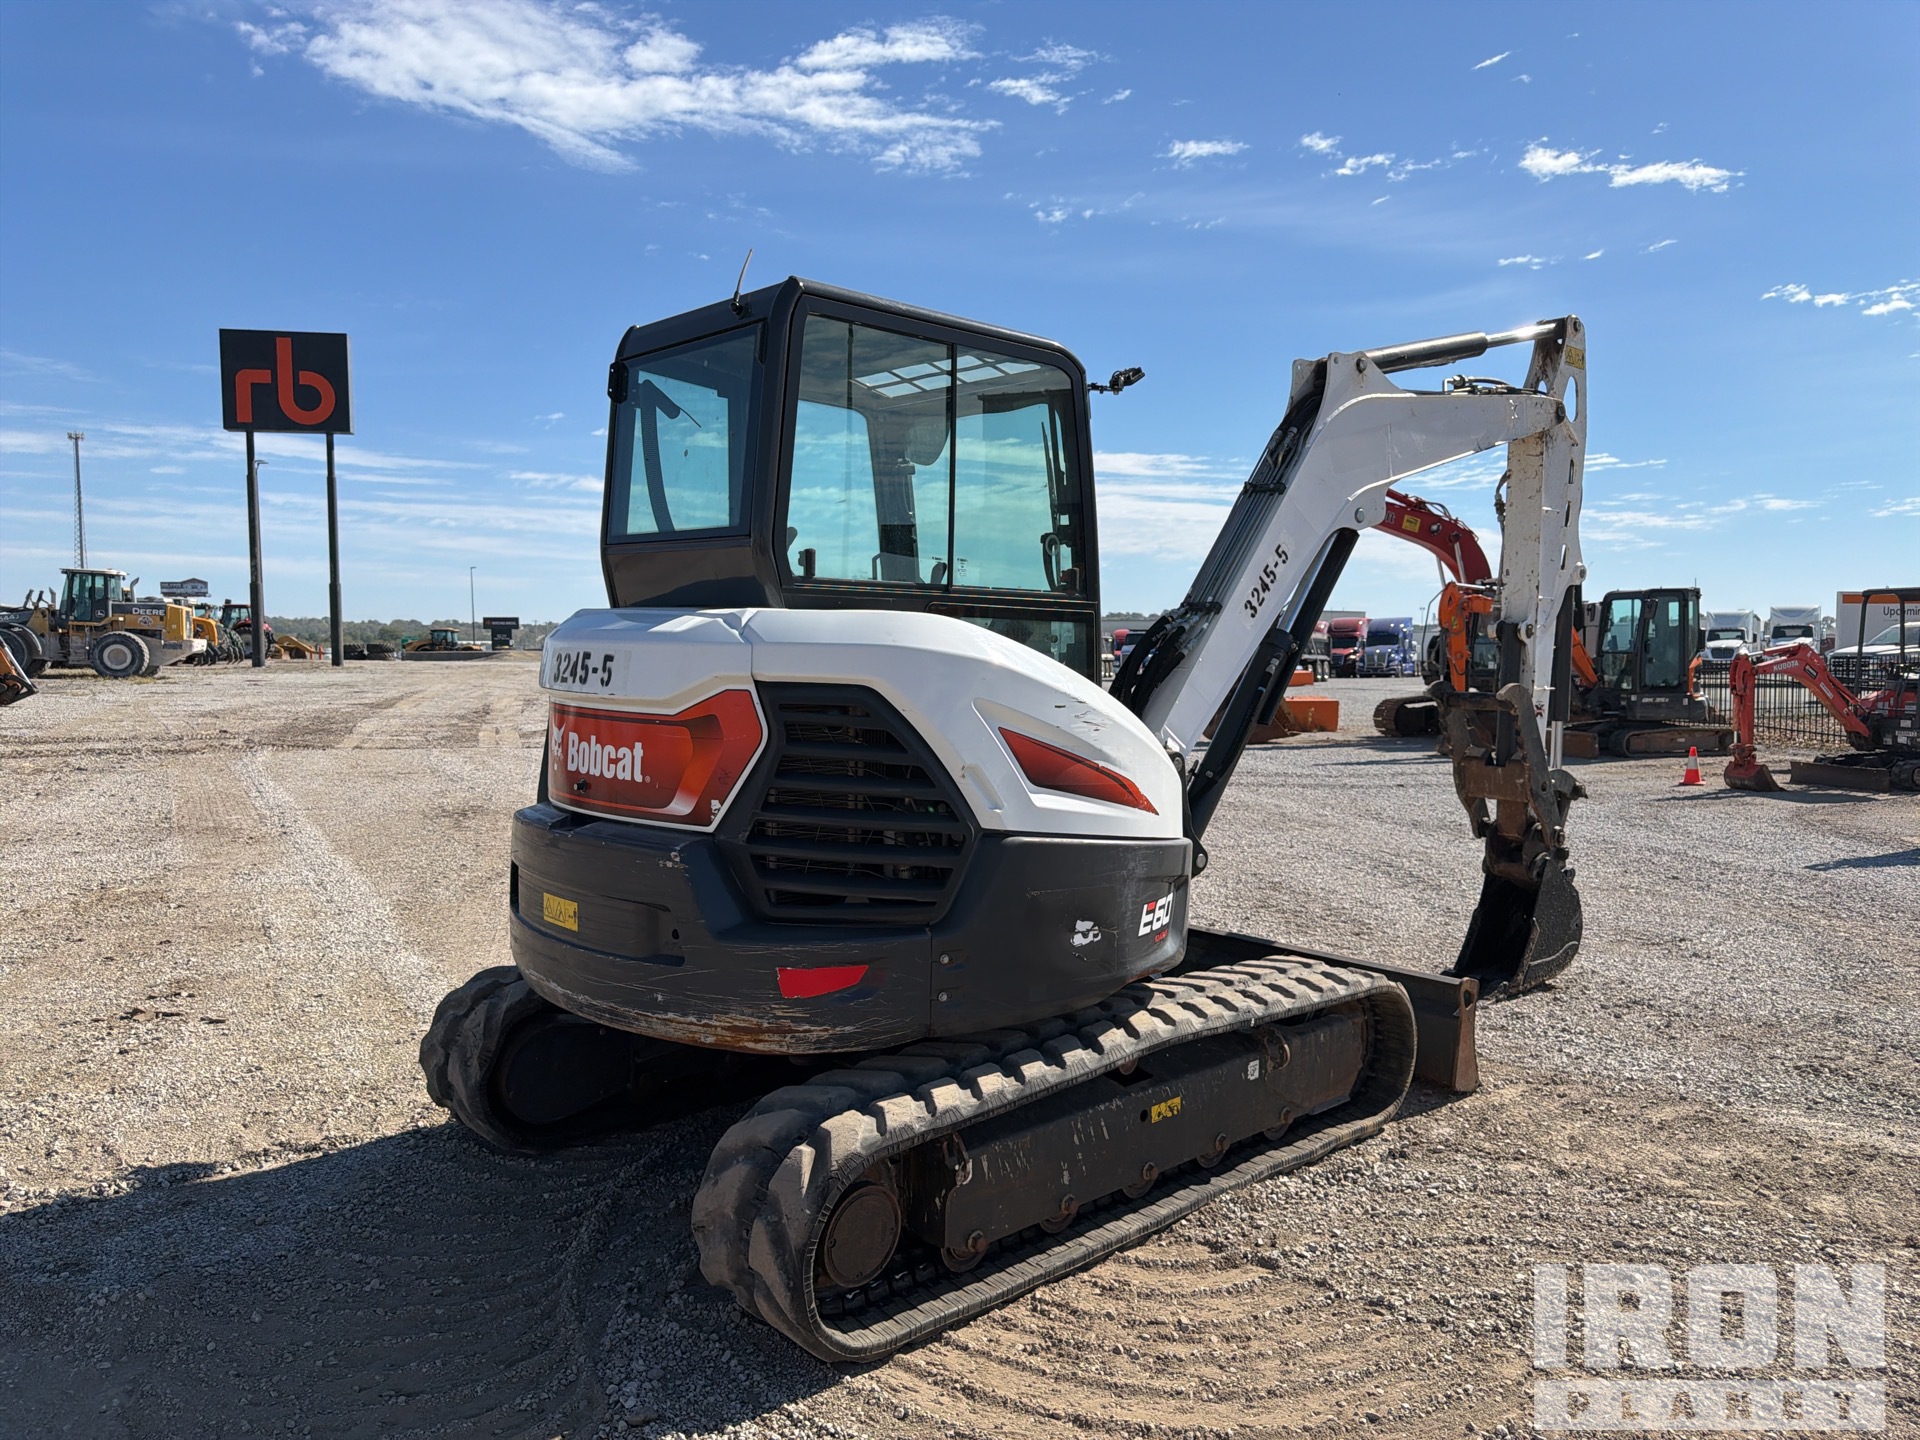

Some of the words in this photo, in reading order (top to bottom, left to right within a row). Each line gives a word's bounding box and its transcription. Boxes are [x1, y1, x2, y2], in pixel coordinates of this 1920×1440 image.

[235, 337, 336, 425] rb
[1244, 544, 1288, 618] 3245-5
[132, 607, 165, 616] DEERE
[1883, 605, 1920, 618] Upcmi
[554, 651, 615, 687] 3245-5
[1773, 660, 1799, 671] KUBOTA
[567, 731, 644, 783] Bobcat
[1138, 892, 1174, 937] E60
